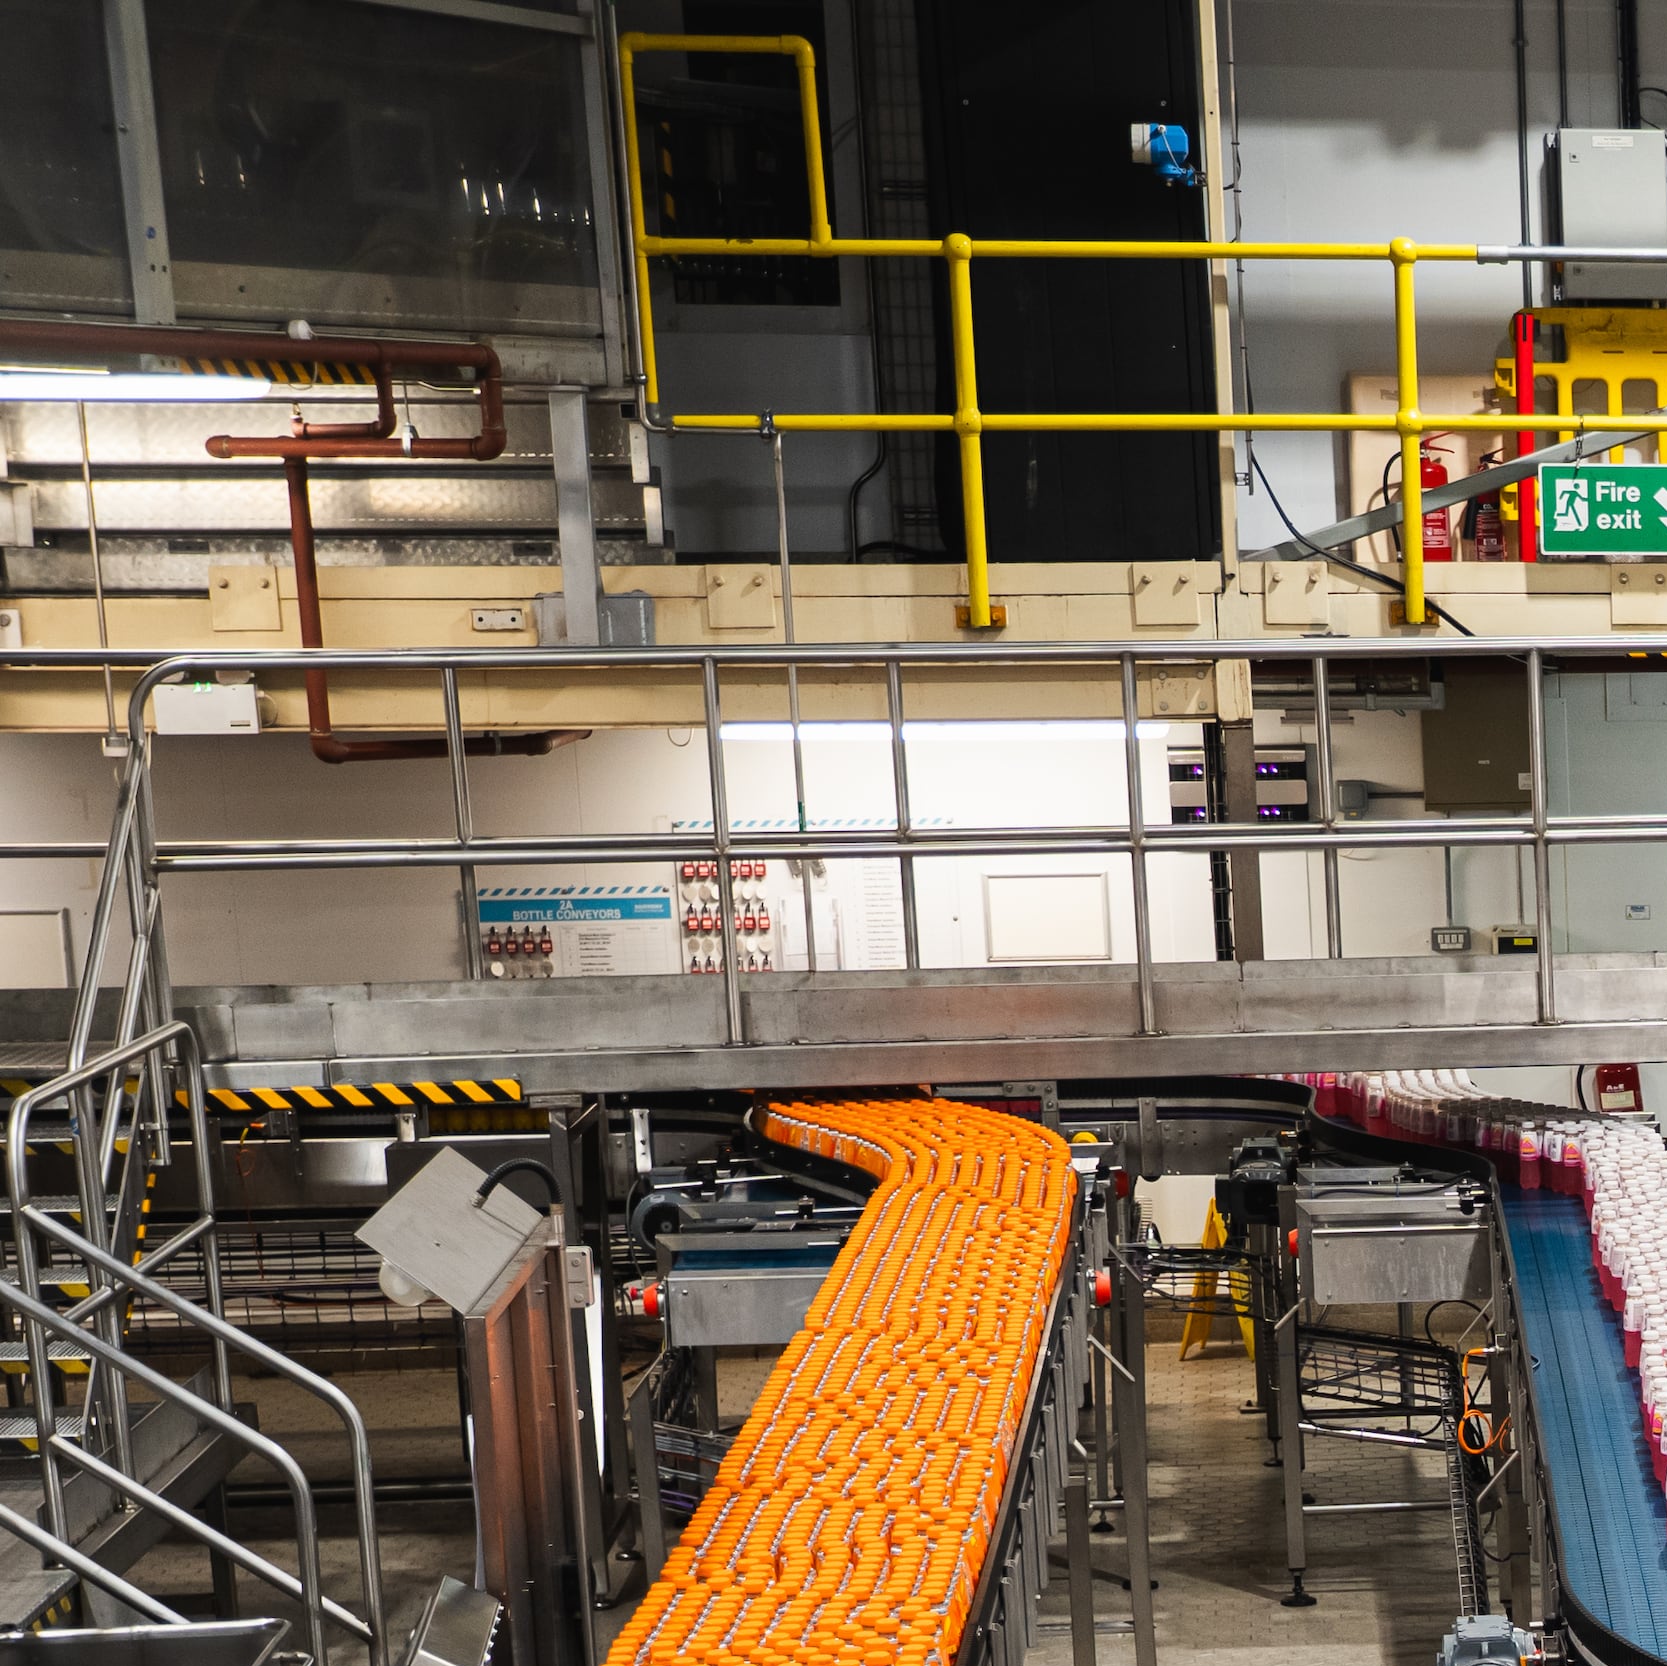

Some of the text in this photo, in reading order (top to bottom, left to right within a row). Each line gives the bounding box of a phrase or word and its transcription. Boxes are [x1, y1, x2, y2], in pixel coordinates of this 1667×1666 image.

[1596, 481, 1642, 503] Fire
[1597, 510, 1643, 530] exit
[559, 900, 574, 910] 2A
[512, 909, 622, 921] BOTTLE CONVEYORS
